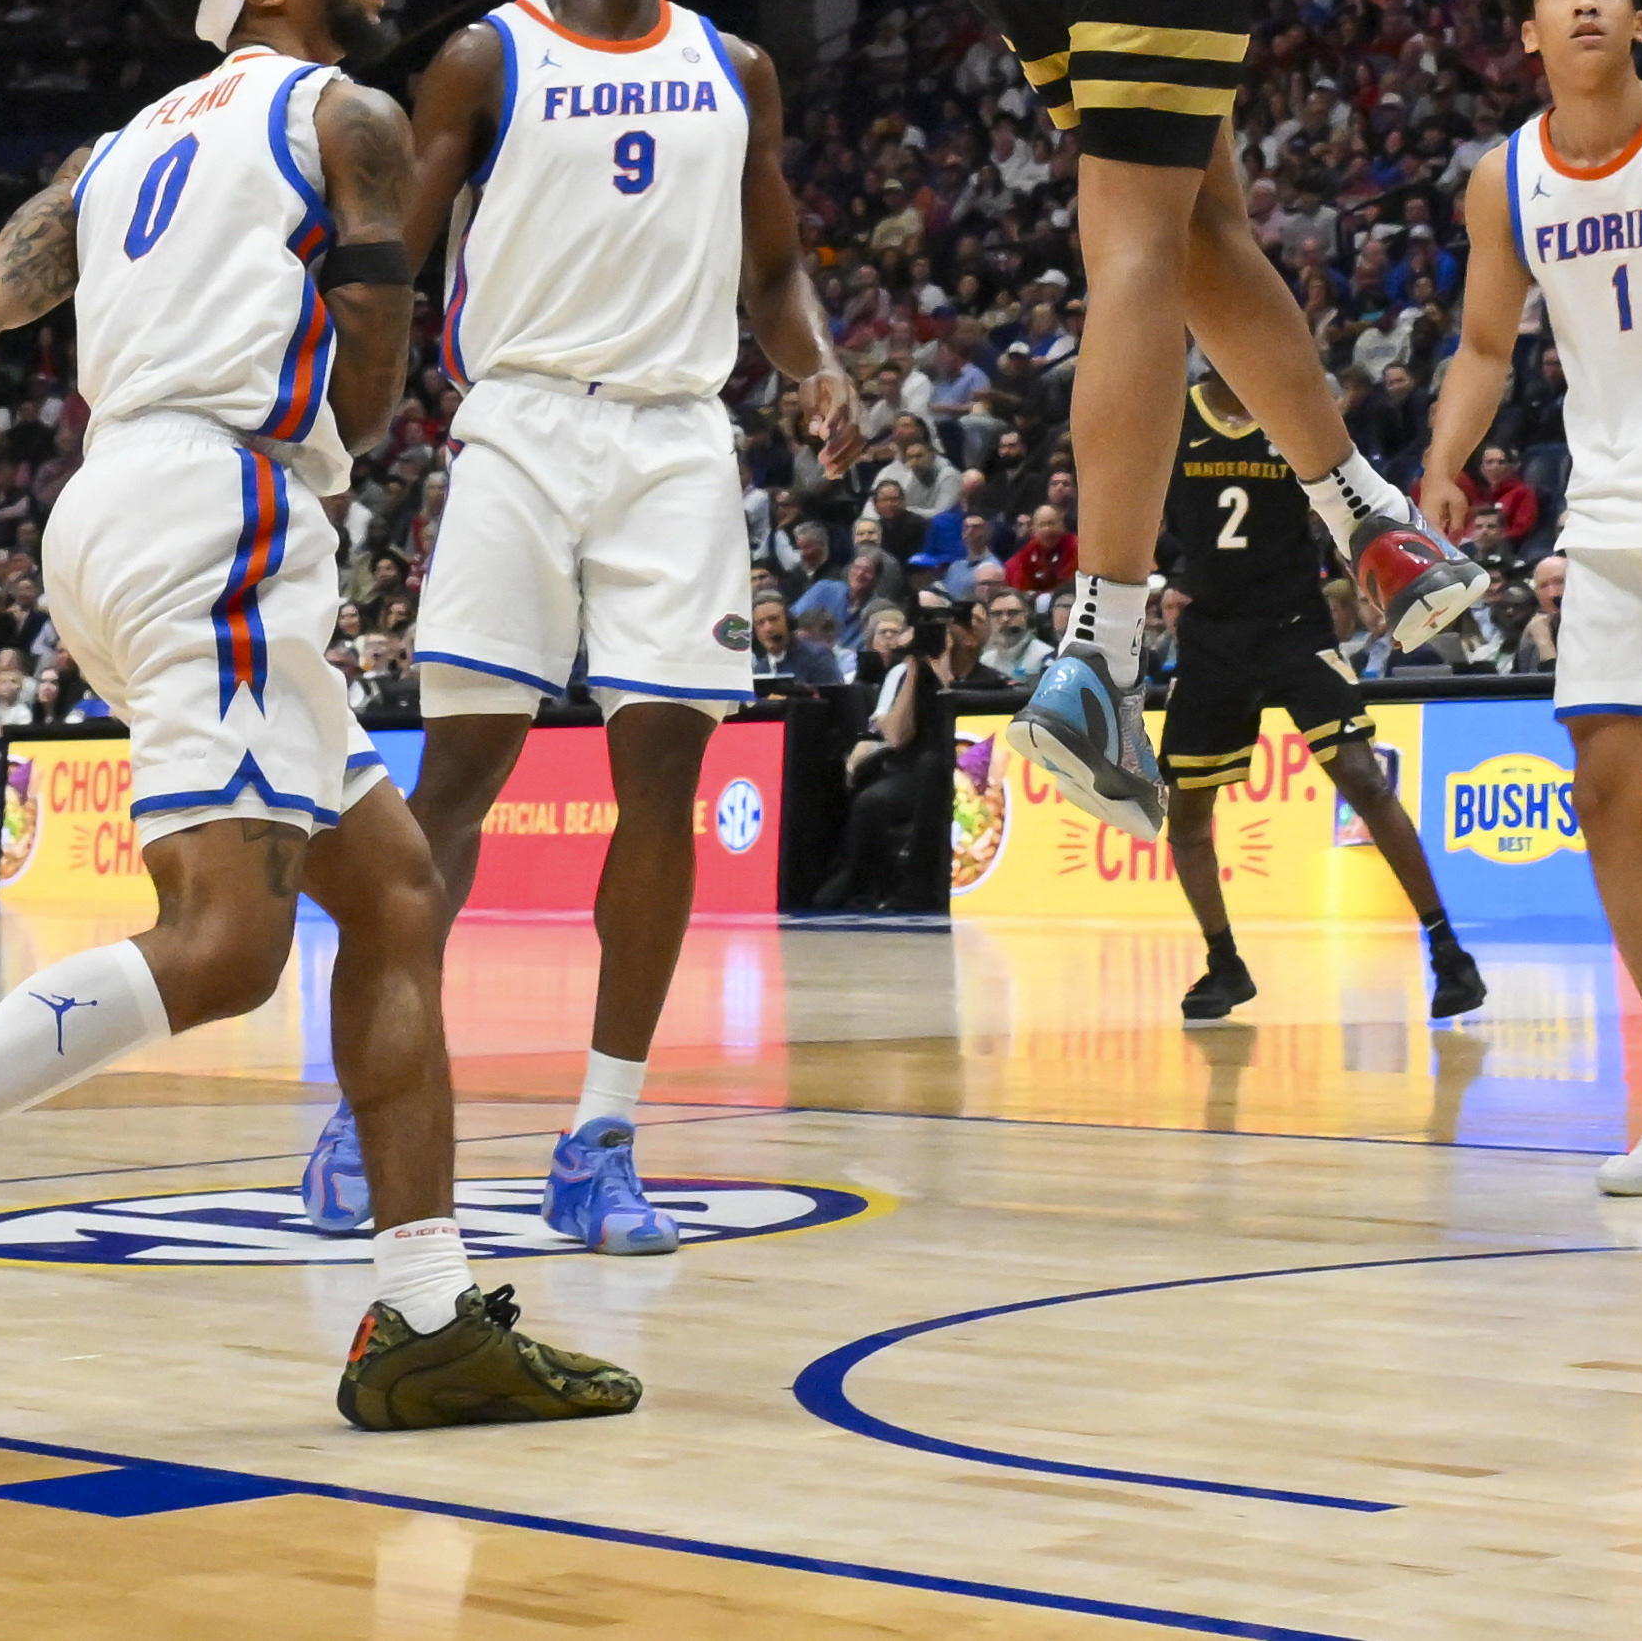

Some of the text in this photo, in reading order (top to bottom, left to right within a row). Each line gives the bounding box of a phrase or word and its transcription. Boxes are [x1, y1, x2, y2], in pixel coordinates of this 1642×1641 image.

[146, 72, 246, 130] FLAND
[541, 80, 718, 121] FLORIDA
[613, 130, 656, 195] 9
[123, 131, 200, 263] 0
[1612, 264, 1634, 332] 1
[1183, 461, 1289, 480] VANDERBILT
[1217, 485, 1250, 550] 2
[481, 801, 619, 835] FFICIAL BEAN
[1454, 780, 1579, 838] BUSH'S
[1498, 836, 1533, 853] BEST
[394, 1225, 459, 1239] Supre
